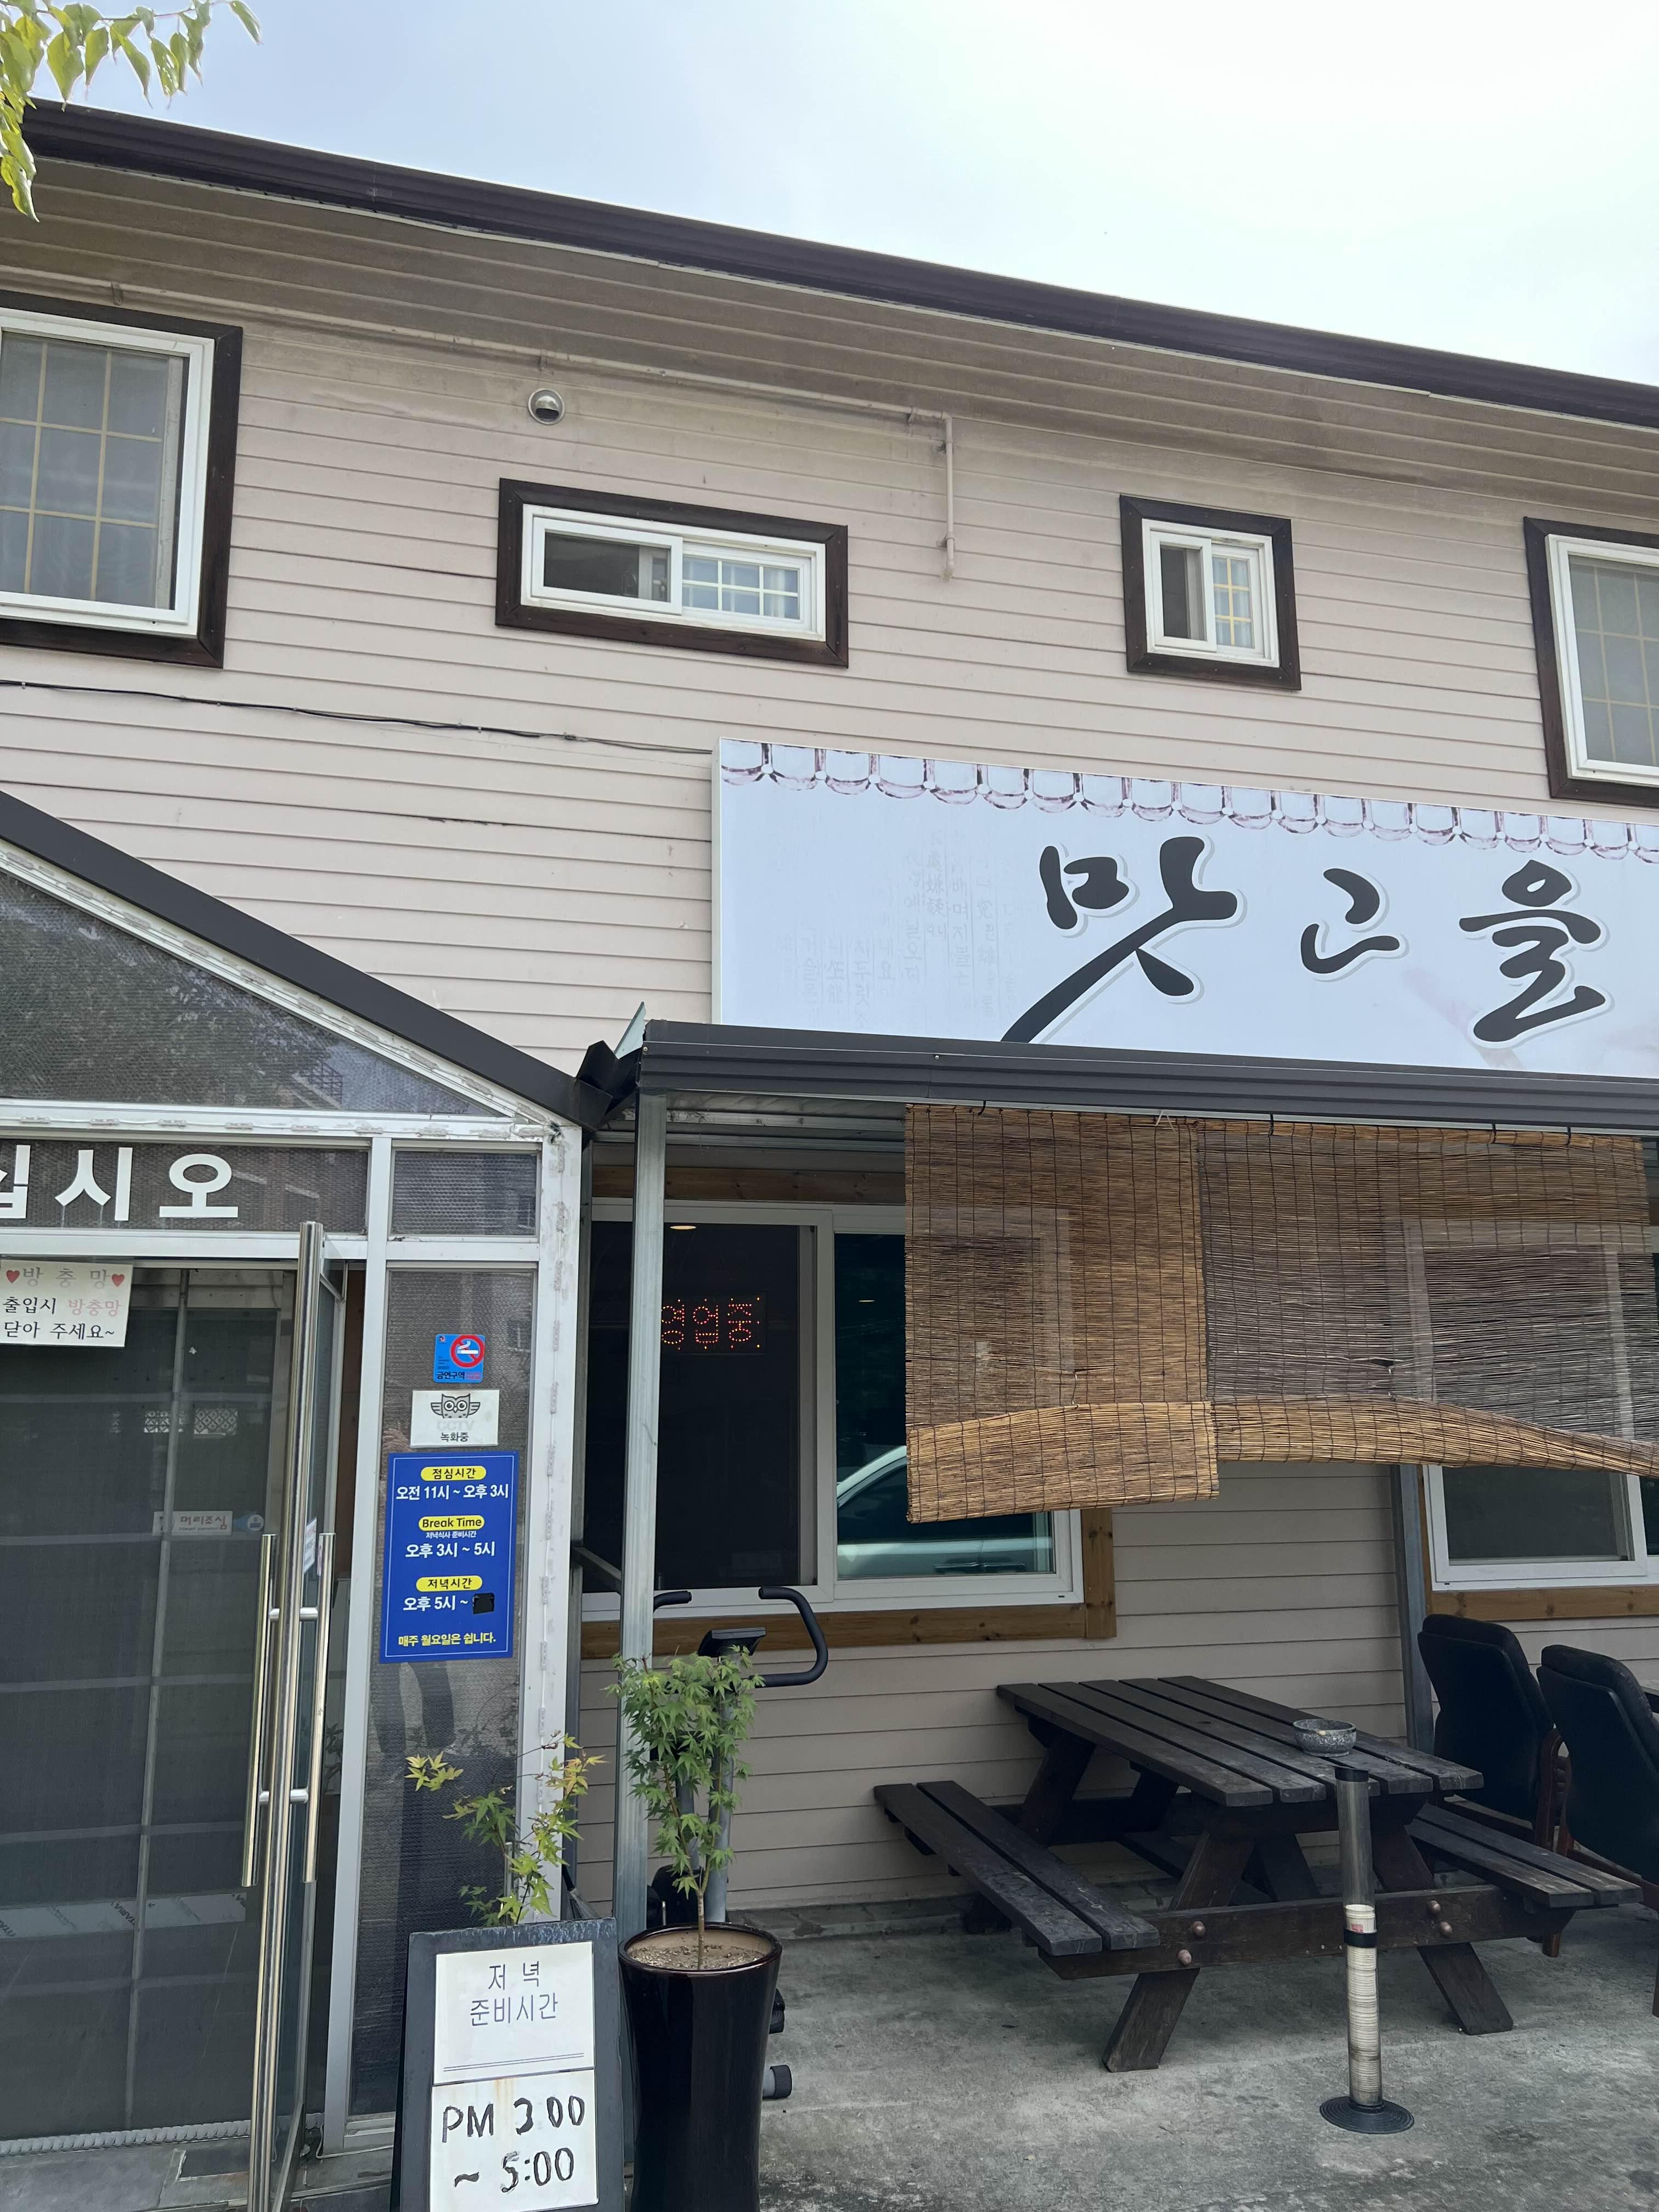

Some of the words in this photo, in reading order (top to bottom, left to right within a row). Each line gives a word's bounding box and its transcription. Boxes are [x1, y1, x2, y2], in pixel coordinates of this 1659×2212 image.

[3, 1296, 56, 1314] 출입시
[68, 1299, 122, 1317] 방충망
[4, 1321, 40, 1338] 닫아
[50, 1323, 115, 1340] 주세요~
[661, 1304, 752, 1344] 영업중
[437, 1371, 465, 1380] 금연구역
[440, 1432, 469, 1442] 녹화중
[432, 1468, 476, 1480] 점심시간
[396, 1486, 420, 1500] 오전
[424, 1485, 449, 1500] 11시
[463, 1484, 487, 1499] 오후
[490, 1483, 509, 1498] 3시
[180, 1516, 228, 1531] 머리조심
[422, 1517, 454, 1528] Break
[456, 1517, 482, 1527] Time
[405, 1543, 433, 1559] 오후
[436, 1542, 458, 1558] 3시
[474, 1542, 495, 1556] 5시
[427, 1578, 472, 1590] 저녁시간
[403, 1596, 431, 1612] 오후
[434, 1595, 456, 1611] 5시
[398, 1635, 419, 1647] 매주
[421, 1633, 461, 1646] 월요일은
[463, 1632, 496, 1645] 쉽니다.
[470, 1992, 558, 2027] 준비시간
[442, 2103, 494, 2143] PM
[500, 2147, 575, 2193] 5:00
